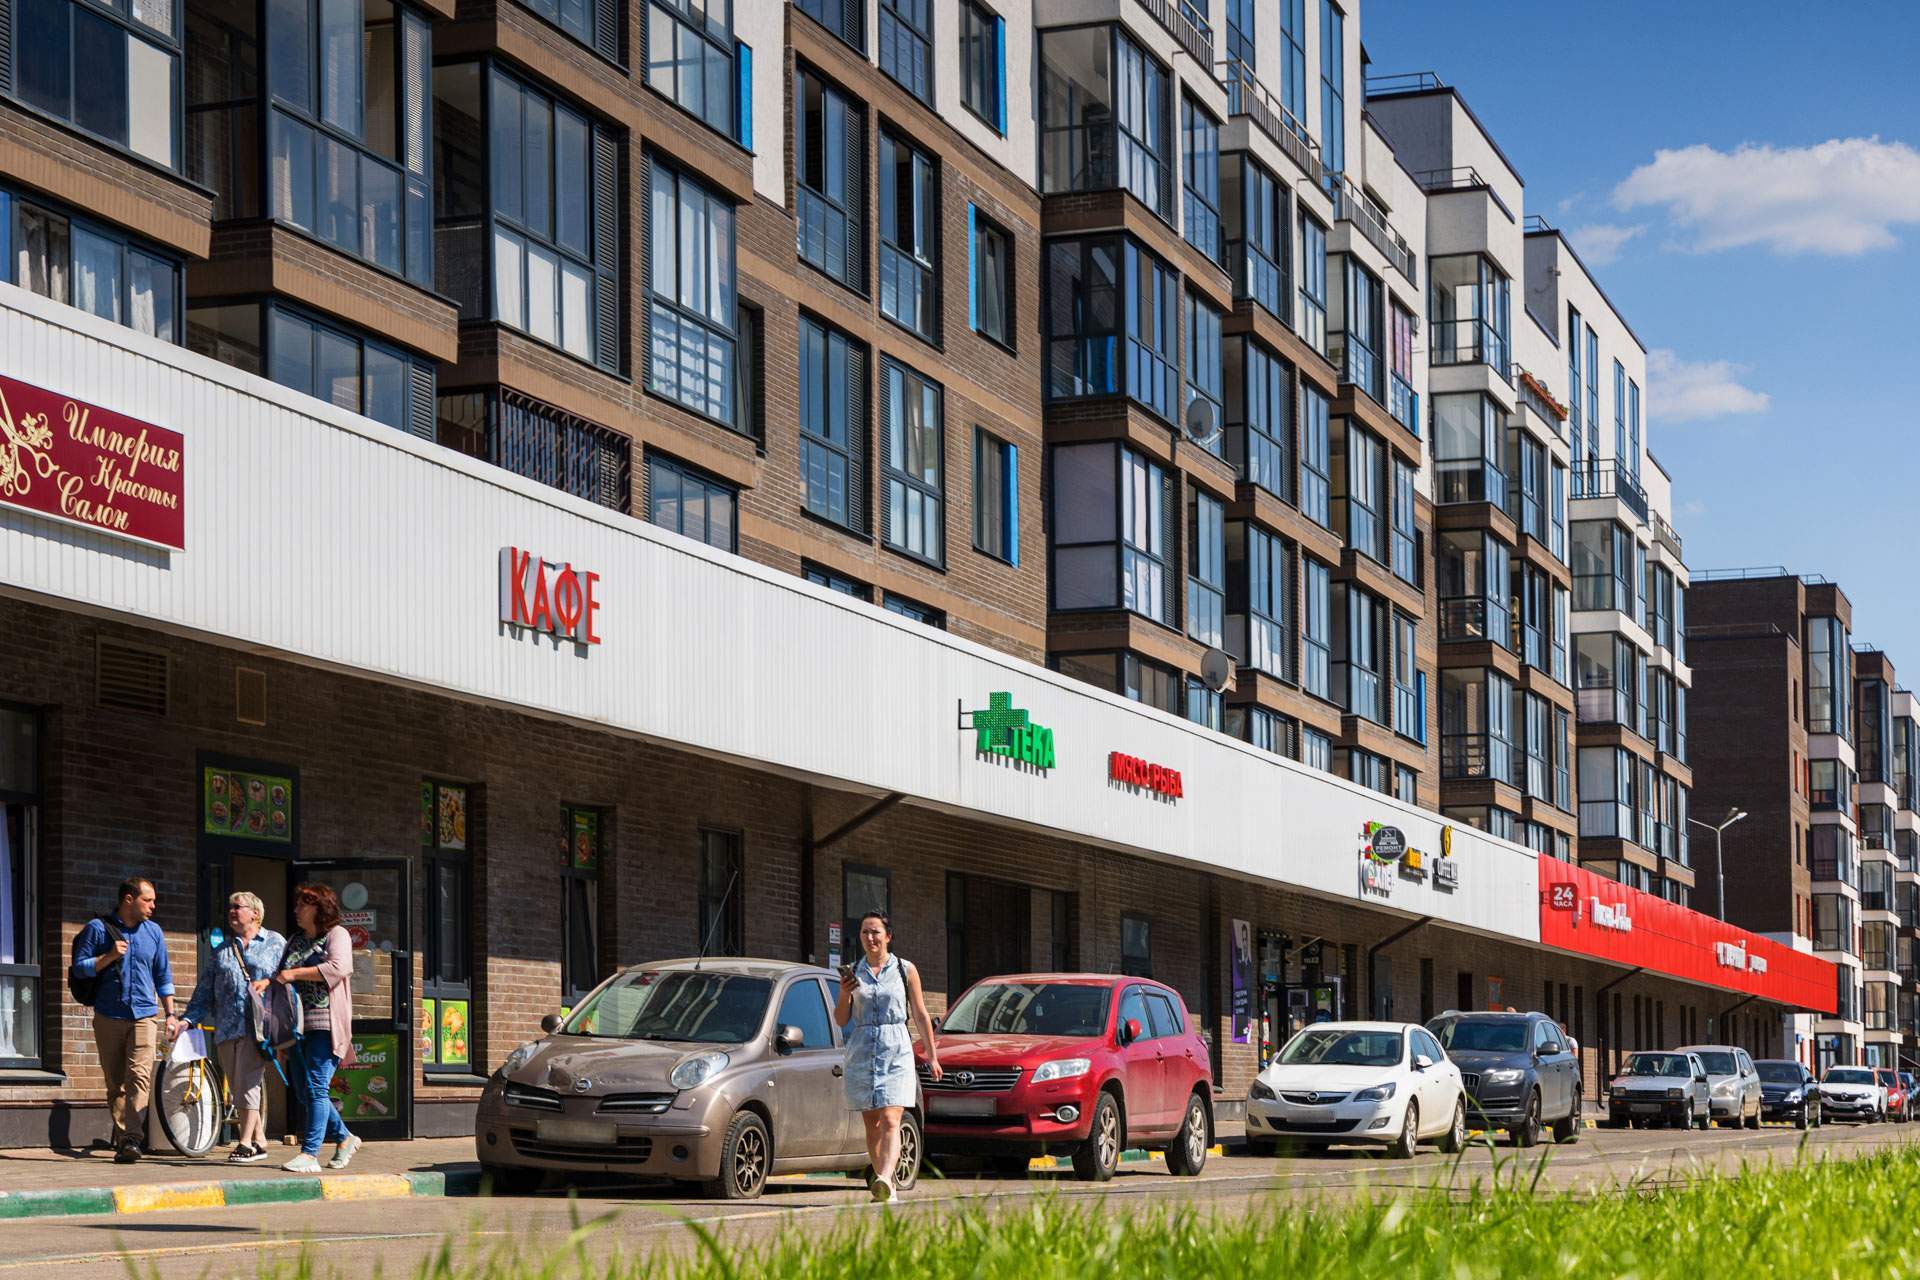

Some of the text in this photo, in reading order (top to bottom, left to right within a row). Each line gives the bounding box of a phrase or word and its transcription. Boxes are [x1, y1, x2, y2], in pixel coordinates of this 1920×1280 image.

[63, 401, 180, 477] Империя
[57, 472, 129, 530] Салон
[90, 455, 178, 509] Красоты
[507, 546, 601, 645] КАФЕ
[977, 722, 1056, 769] ТЕКА
[1111, 751, 1183, 798] МЯСО РЫБА
[1554, 886, 1574, 900] 24
[355, 1051, 387, 1063] ебаб
